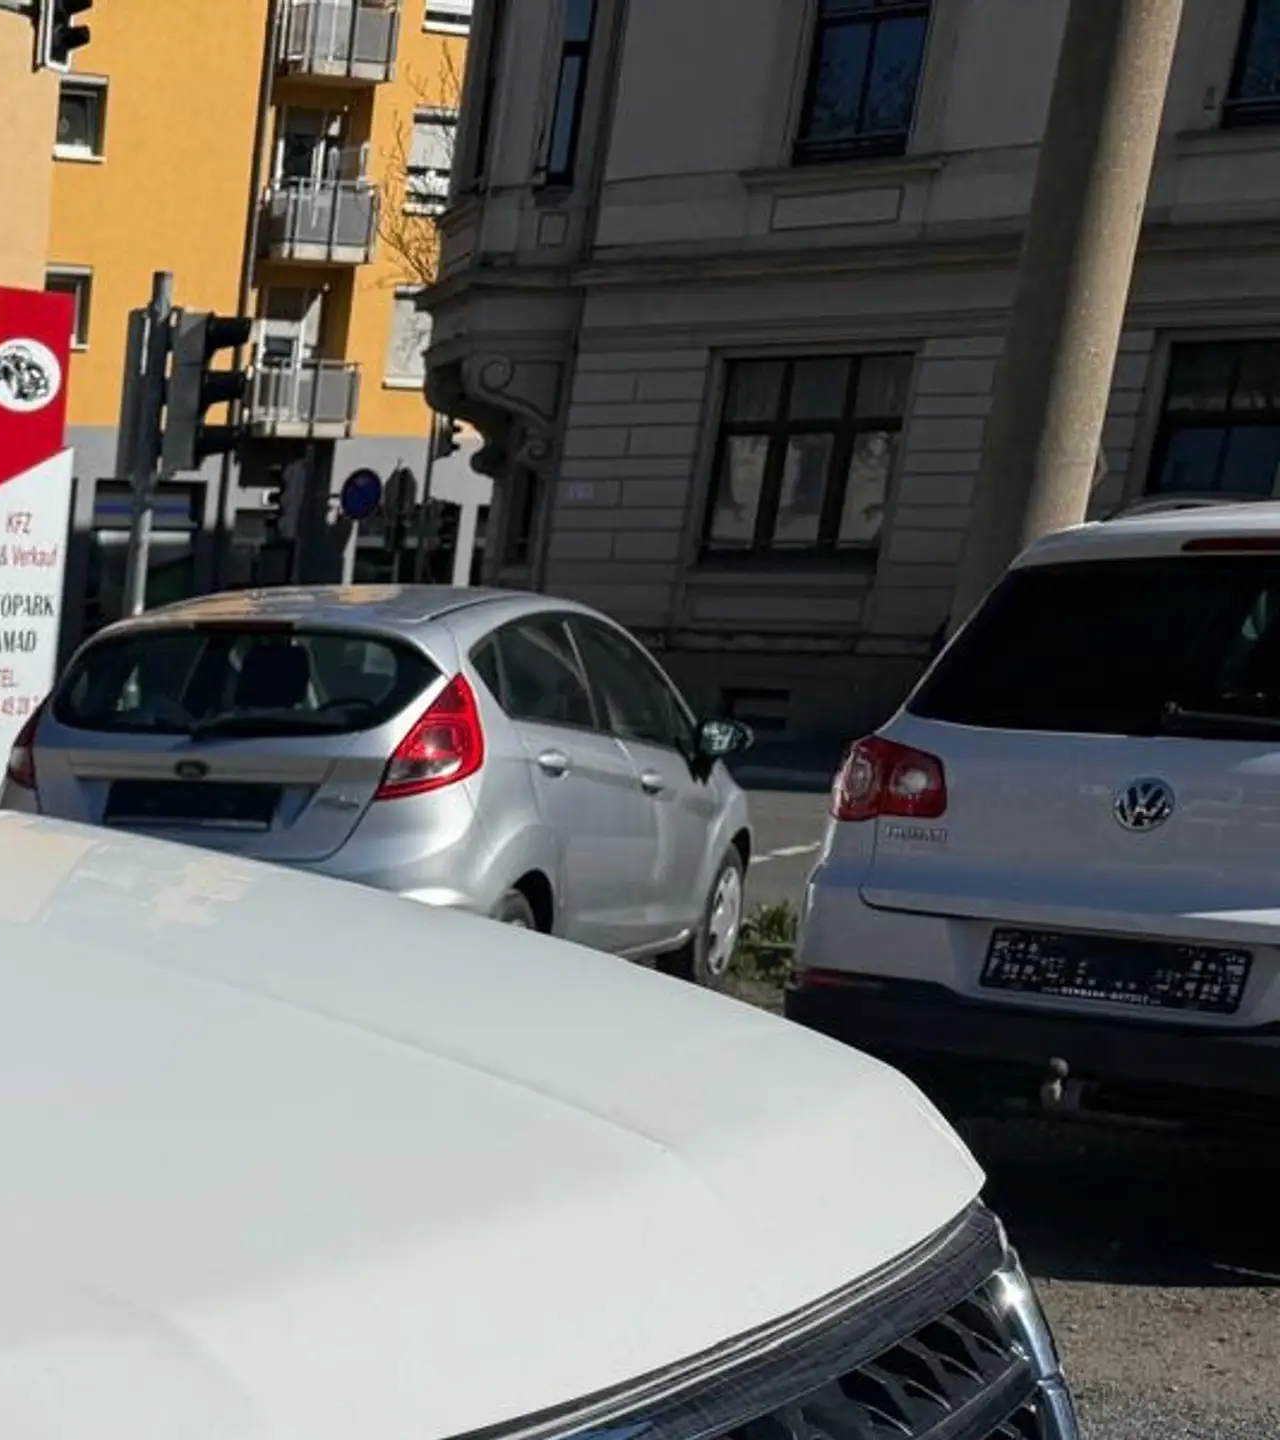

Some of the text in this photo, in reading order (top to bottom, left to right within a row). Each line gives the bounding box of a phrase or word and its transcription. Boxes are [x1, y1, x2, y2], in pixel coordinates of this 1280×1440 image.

[5, 511, 32, 533] KFZ
[0, 543, 9, 565] &
[11, 543, 58, 566] Verkauf
